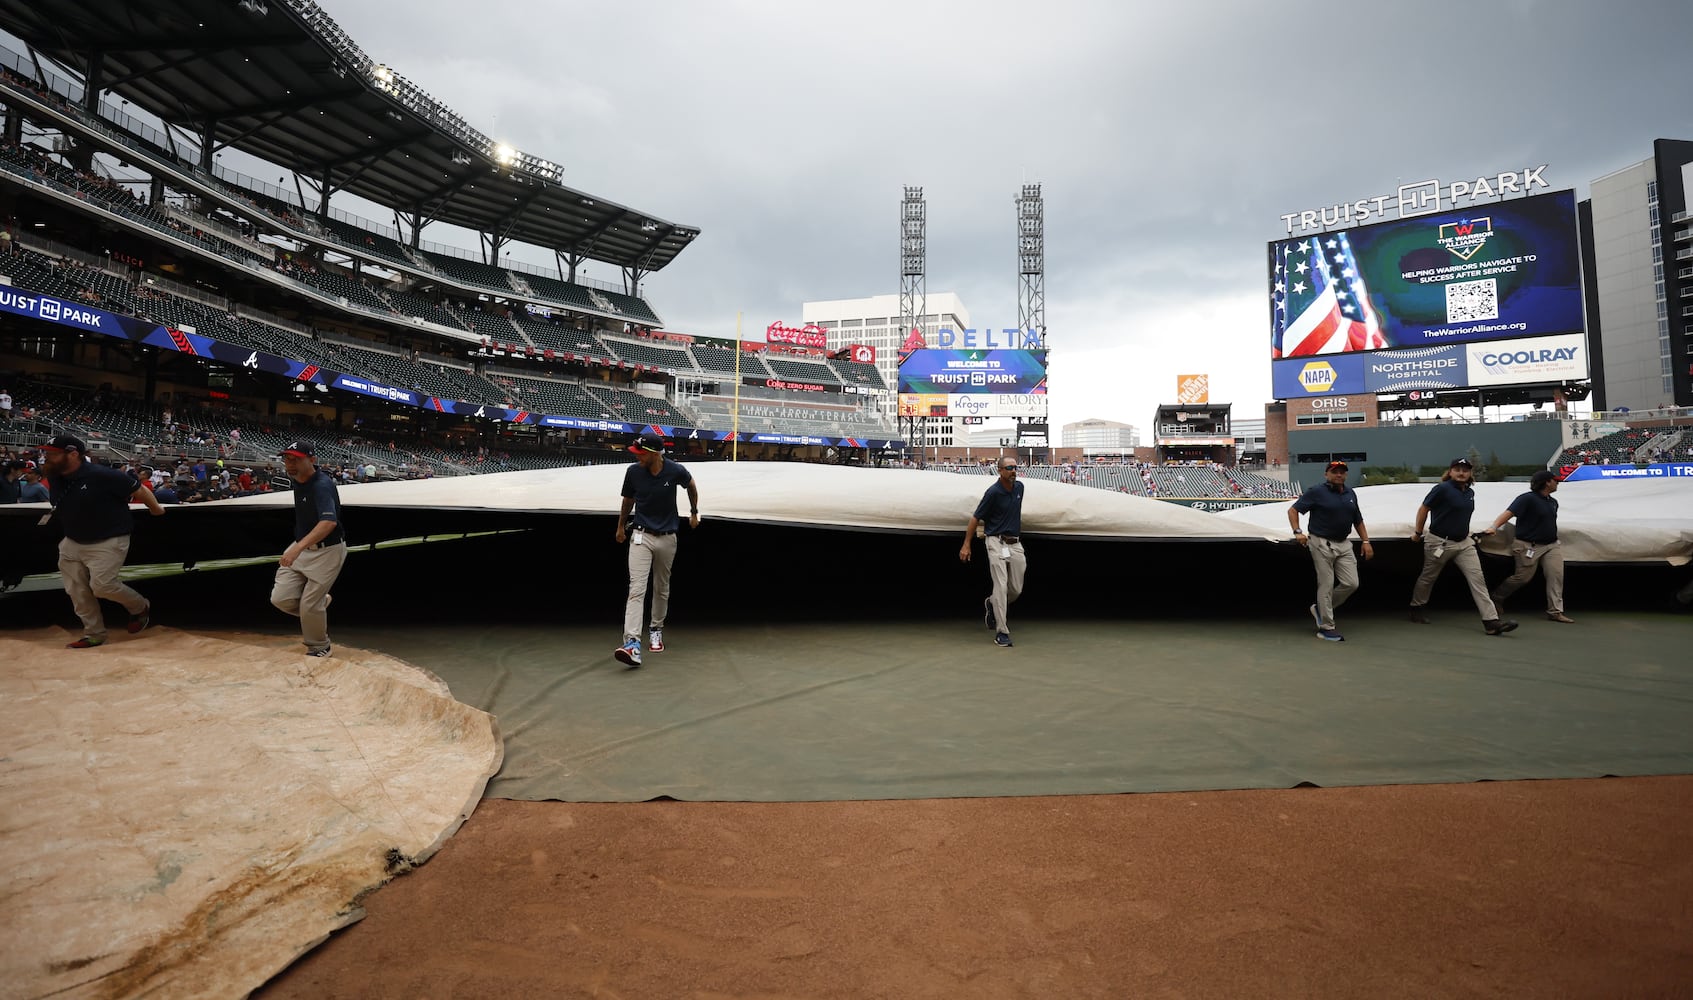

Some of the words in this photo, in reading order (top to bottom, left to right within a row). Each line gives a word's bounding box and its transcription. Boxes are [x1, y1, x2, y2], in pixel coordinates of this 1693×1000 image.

[1280, 194, 1390, 232] TRUIST
[1450, 164, 1549, 203] PARK
[1445, 238, 1486, 249] ALLIANCE
[1455, 231, 1493, 242] WARRIOR
[1402, 269, 1435, 279] HELPING
[1436, 262, 1478, 274] WARRIORS
[1479, 256, 1522, 270] NAVIGATE
[1524, 254, 1537, 262] TO
[1420, 273, 1454, 283] SUCCESS
[1455, 270, 1481, 278] AFTER
[1483, 265, 1517, 275] SERVICE
[0, 291, 38, 311] UIST
[63, 307, 101, 327] PARK
[1423, 321, 1527, 338] TheWarriorAlliance.org
[938, 328, 1042, 347] DELTA
[1482, 346, 1578, 366] COOLRAY
[1372, 358, 1458, 373] NORTHSIDE
[930, 374, 969, 384] TRUIST
[987, 374, 1016, 384] PARK
[1304, 369, 1331, 384] NAPA
[1387, 370, 1442, 379] HOSPITAL
[766, 379, 786, 389] Coke
[1178, 374, 1208, 402] HOME
[371, 384, 389, 396] TRUIST
[397, 391, 410, 401] PARK
[999, 394, 1043, 405] EMORY
[1421, 391, 1434, 399] LG
[955, 395, 989, 414] Kroger
[1311, 398, 1348, 409] ORIS
[742, 405, 775, 418] HANK
[780, 408, 815, 420] AARON
[820, 411, 866, 423] TERRACE
[578, 420, 599, 428] TRUIST
[1601, 469, 1647, 477] WELCOME
